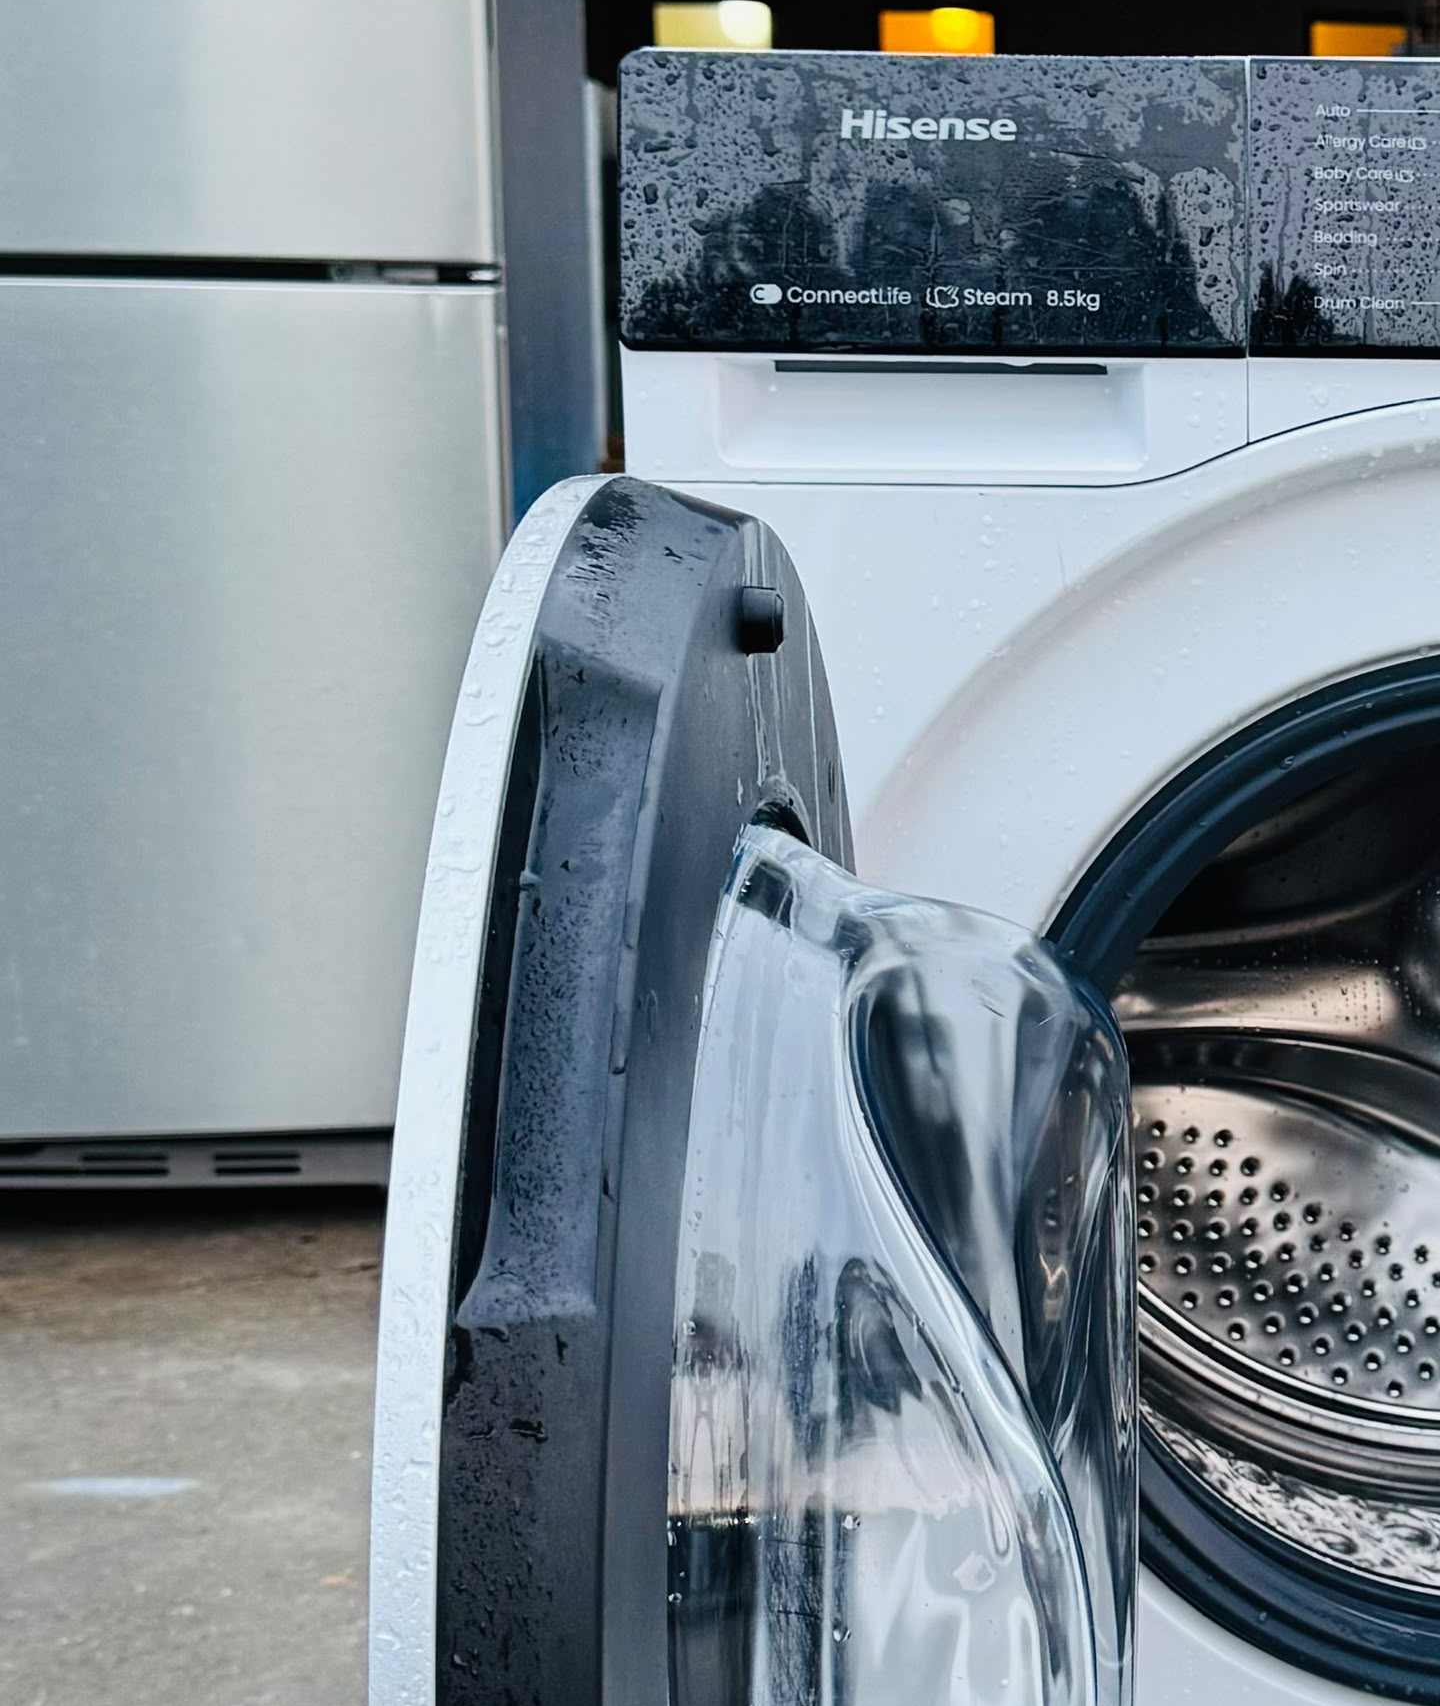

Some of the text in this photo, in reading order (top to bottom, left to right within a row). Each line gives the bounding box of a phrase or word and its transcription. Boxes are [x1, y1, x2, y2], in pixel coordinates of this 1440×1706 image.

[1315, 104, 1350, 117] Auto
[841, 109, 1017, 142] Hisense
[1315, 134, 1405, 150] Allergy Care
[1314, 166, 1393, 183] Baby Care
[1314, 198, 1401, 214] Sportswear
[1314, 230, 1377, 247] Bedding
[1314, 263, 1347, 278] Spin
[786, 286, 911, 305] ConnectLife
[964, 288, 1032, 306] Steam
[1046, 290, 1100, 311] 8.5kg
[1314, 296, 1405, 310] Drum Clean
